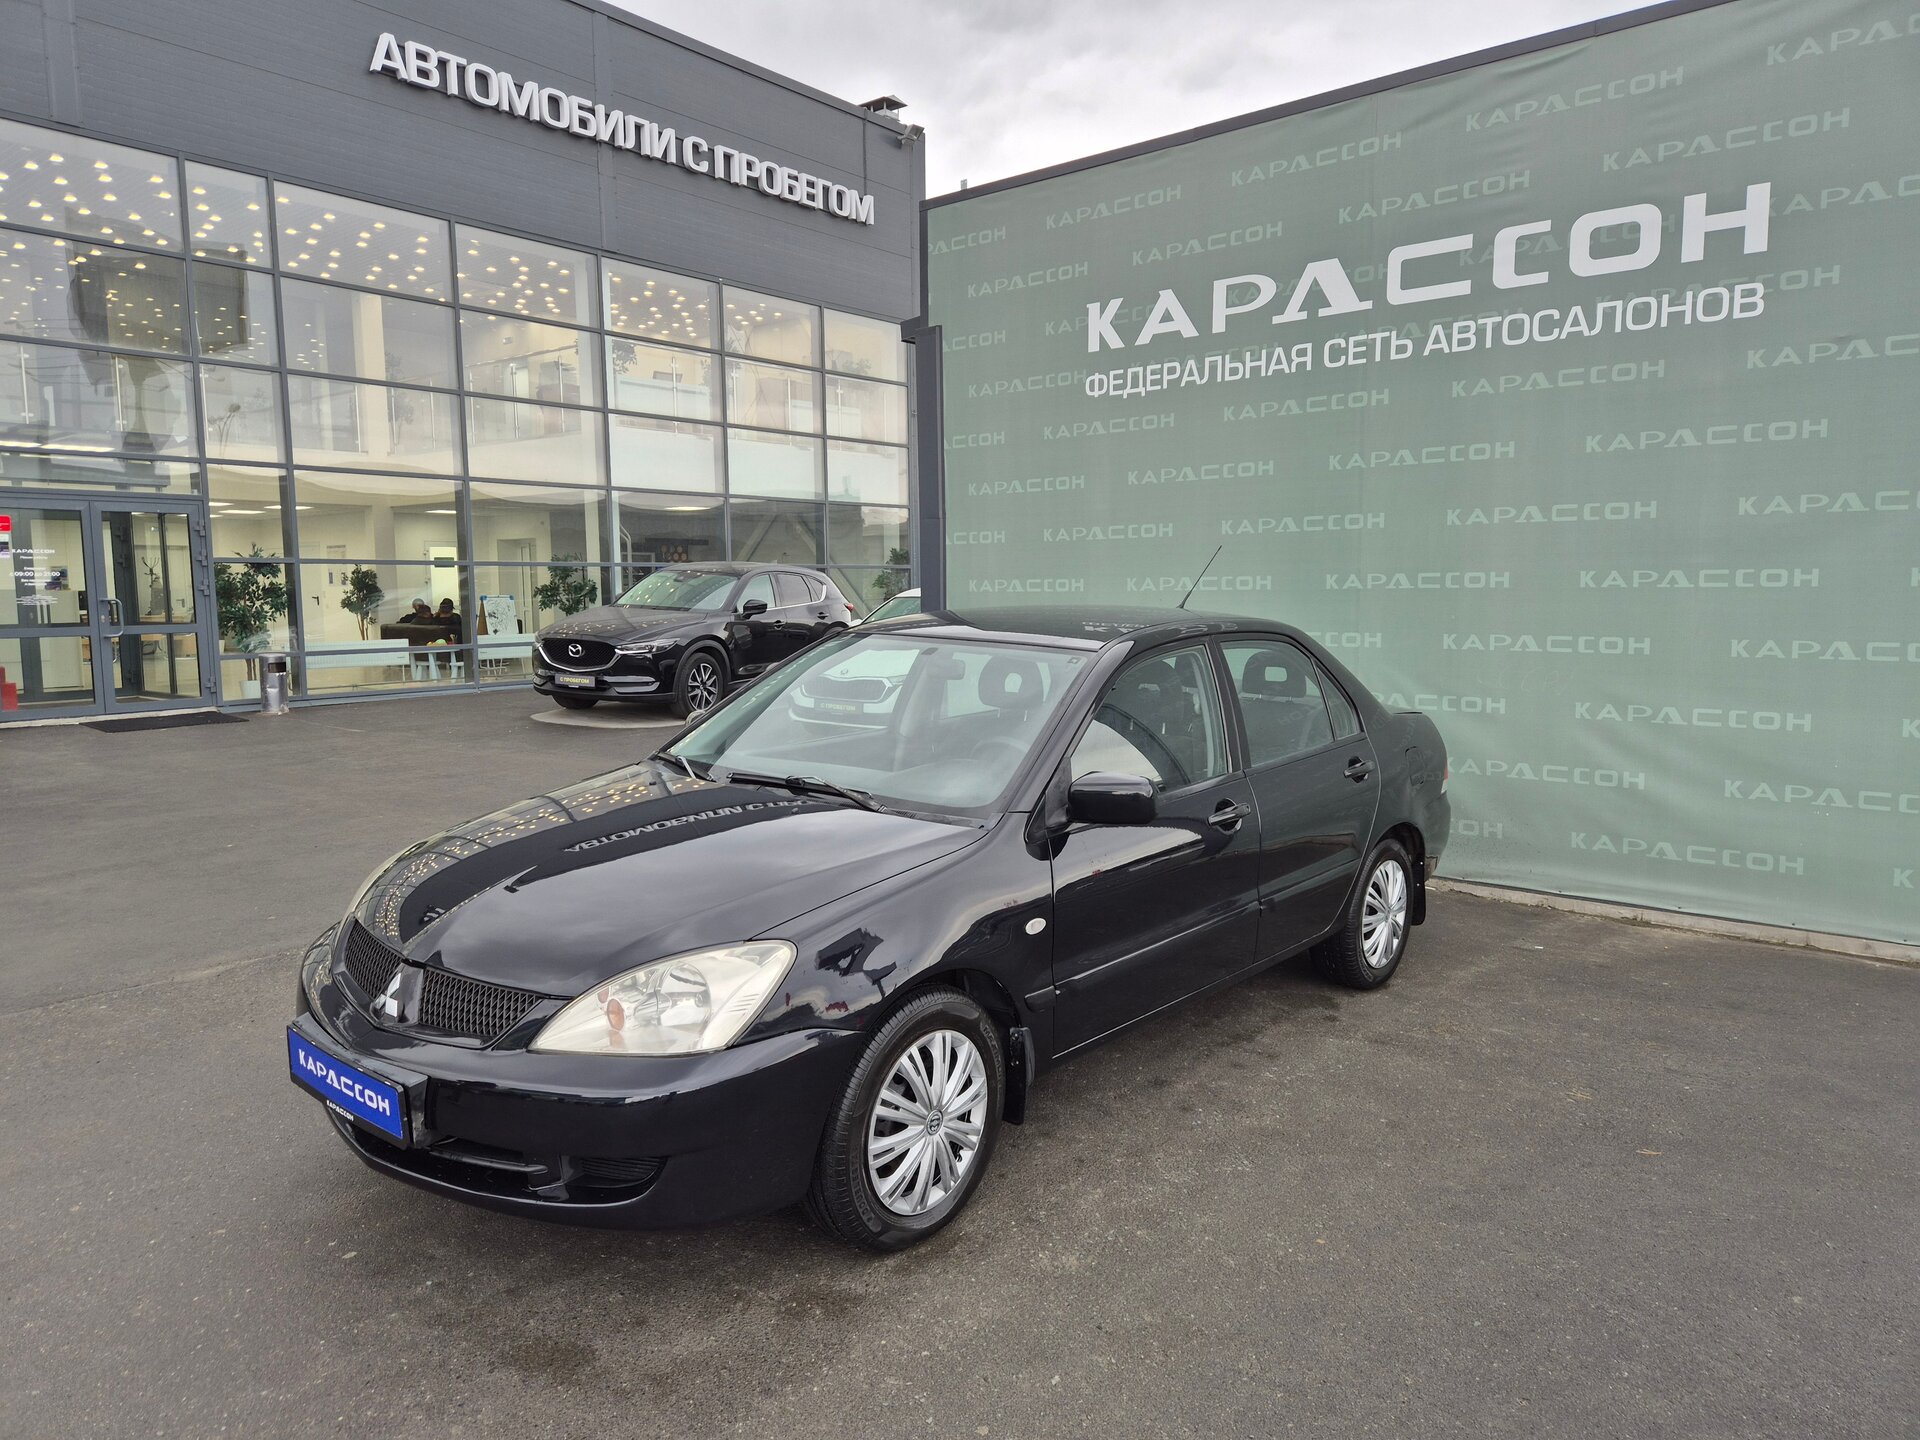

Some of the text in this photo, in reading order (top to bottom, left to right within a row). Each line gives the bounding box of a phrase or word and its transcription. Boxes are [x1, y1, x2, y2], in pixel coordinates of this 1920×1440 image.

[1466, 66, 1684, 132] КАРАССОН
[369, 32, 875, 225] АВТОМОБИЛИ С ПРОБЕГОМ
[1603, 108, 1850, 171] КАРАССОН
[1231, 132, 1402, 187] КАРАССОН
[1046, 184, 1181, 230] КАРАССОН
[1338, 170, 1531, 225] КАРАССОН
[1132, 221, 1284, 267] КАРАССОН
[967, 261, 1089, 298] КАРАССОН
[1086, 182, 1772, 353] КАРАССОН
[1085, 283, 1765, 398] ФЕДЕРАЛЬНАЯ СЕТЬ АВТОСАЛОНОВ
[1452, 360, 1665, 398] КАРАССОН
[1223, 388, 1389, 422] КАРАССОН
[1043, 412, 1175, 440] КАРАССОН
[1586, 418, 1828, 454] КАРАССОН
[1328, 441, 1515, 470] КАРАССОН
[968, 475, 1085, 496] КАРАССОН
[1127, 460, 1275, 486] КАРАССОН
[1447, 501, 1657, 526] КАРАССОН
[1739, 490, 1920, 516] КАРАС
[1043, 523, 1174, 542] КАРАССОН
[1221, 512, 1385, 536] КАРАССОН
[968, 578, 1085, 593] КАРАССОН
[1126, 575, 1272, 592] КАРАССОН
[1325, 571, 1510, 590] КАРАССОН
[1580, 568, 1819, 588] КАРАССОН
[1443, 634, 1651, 655] КАРАССОН
[1575, 702, 1812, 732] КАРАССОН
[1571, 831, 1804, 876] КАРАССОН
[298, 1048, 391, 1117] КАРАССОН
